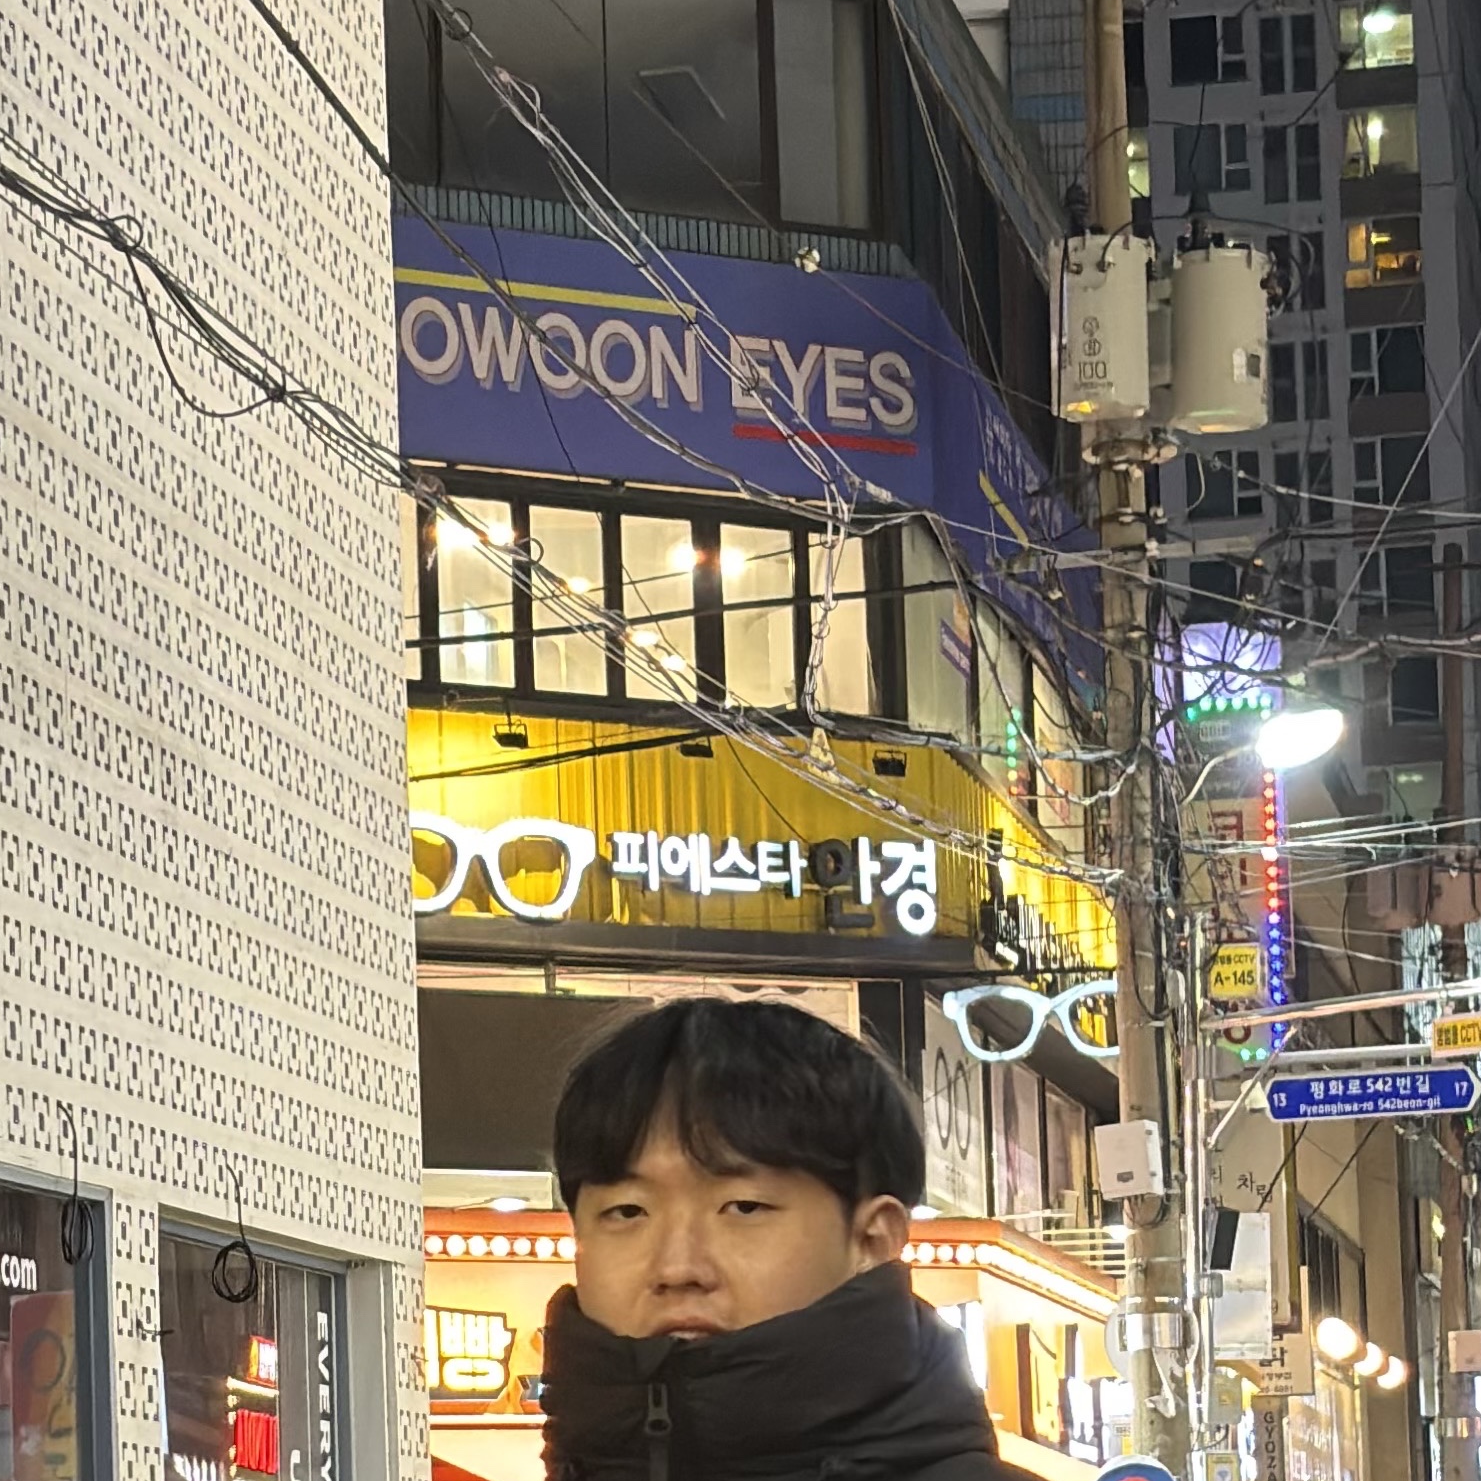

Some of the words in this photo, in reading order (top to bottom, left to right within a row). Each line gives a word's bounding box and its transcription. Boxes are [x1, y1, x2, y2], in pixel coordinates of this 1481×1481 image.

[730, 335, 918, 434] EYES
[610, 831, 807, 897] 피에스타
[813, 835, 938, 936] 안경
[1213, 971, 1255, 988] A-145
[1272, 1092, 1287, 1108] 13
[1453, 1080, 1469, 1097] 17
